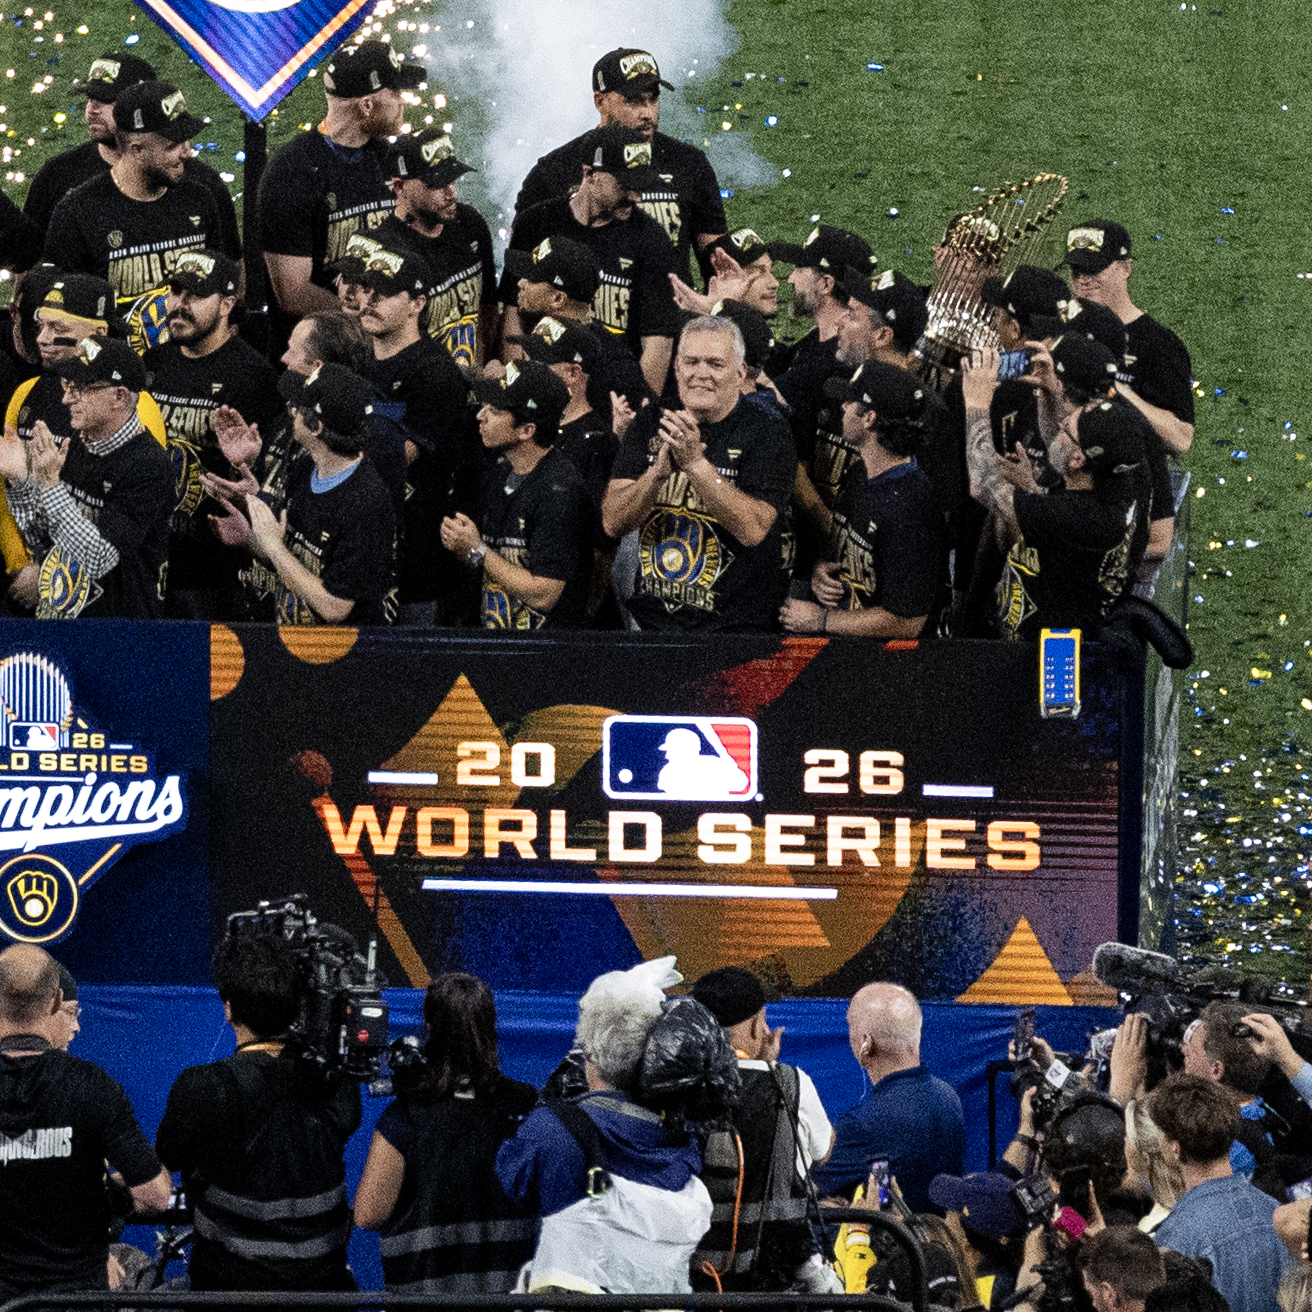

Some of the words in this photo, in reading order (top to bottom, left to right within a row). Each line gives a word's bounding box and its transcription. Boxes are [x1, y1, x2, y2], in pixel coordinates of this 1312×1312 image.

[72, 732, 105, 749] 26
[39, 754, 148, 772] SERIES
[456, 741, 556, 787] 20
[803, 749, 905, 795] 26
[324, 804, 663, 863] WORLD
[696, 812, 1041, 870] SERIES
